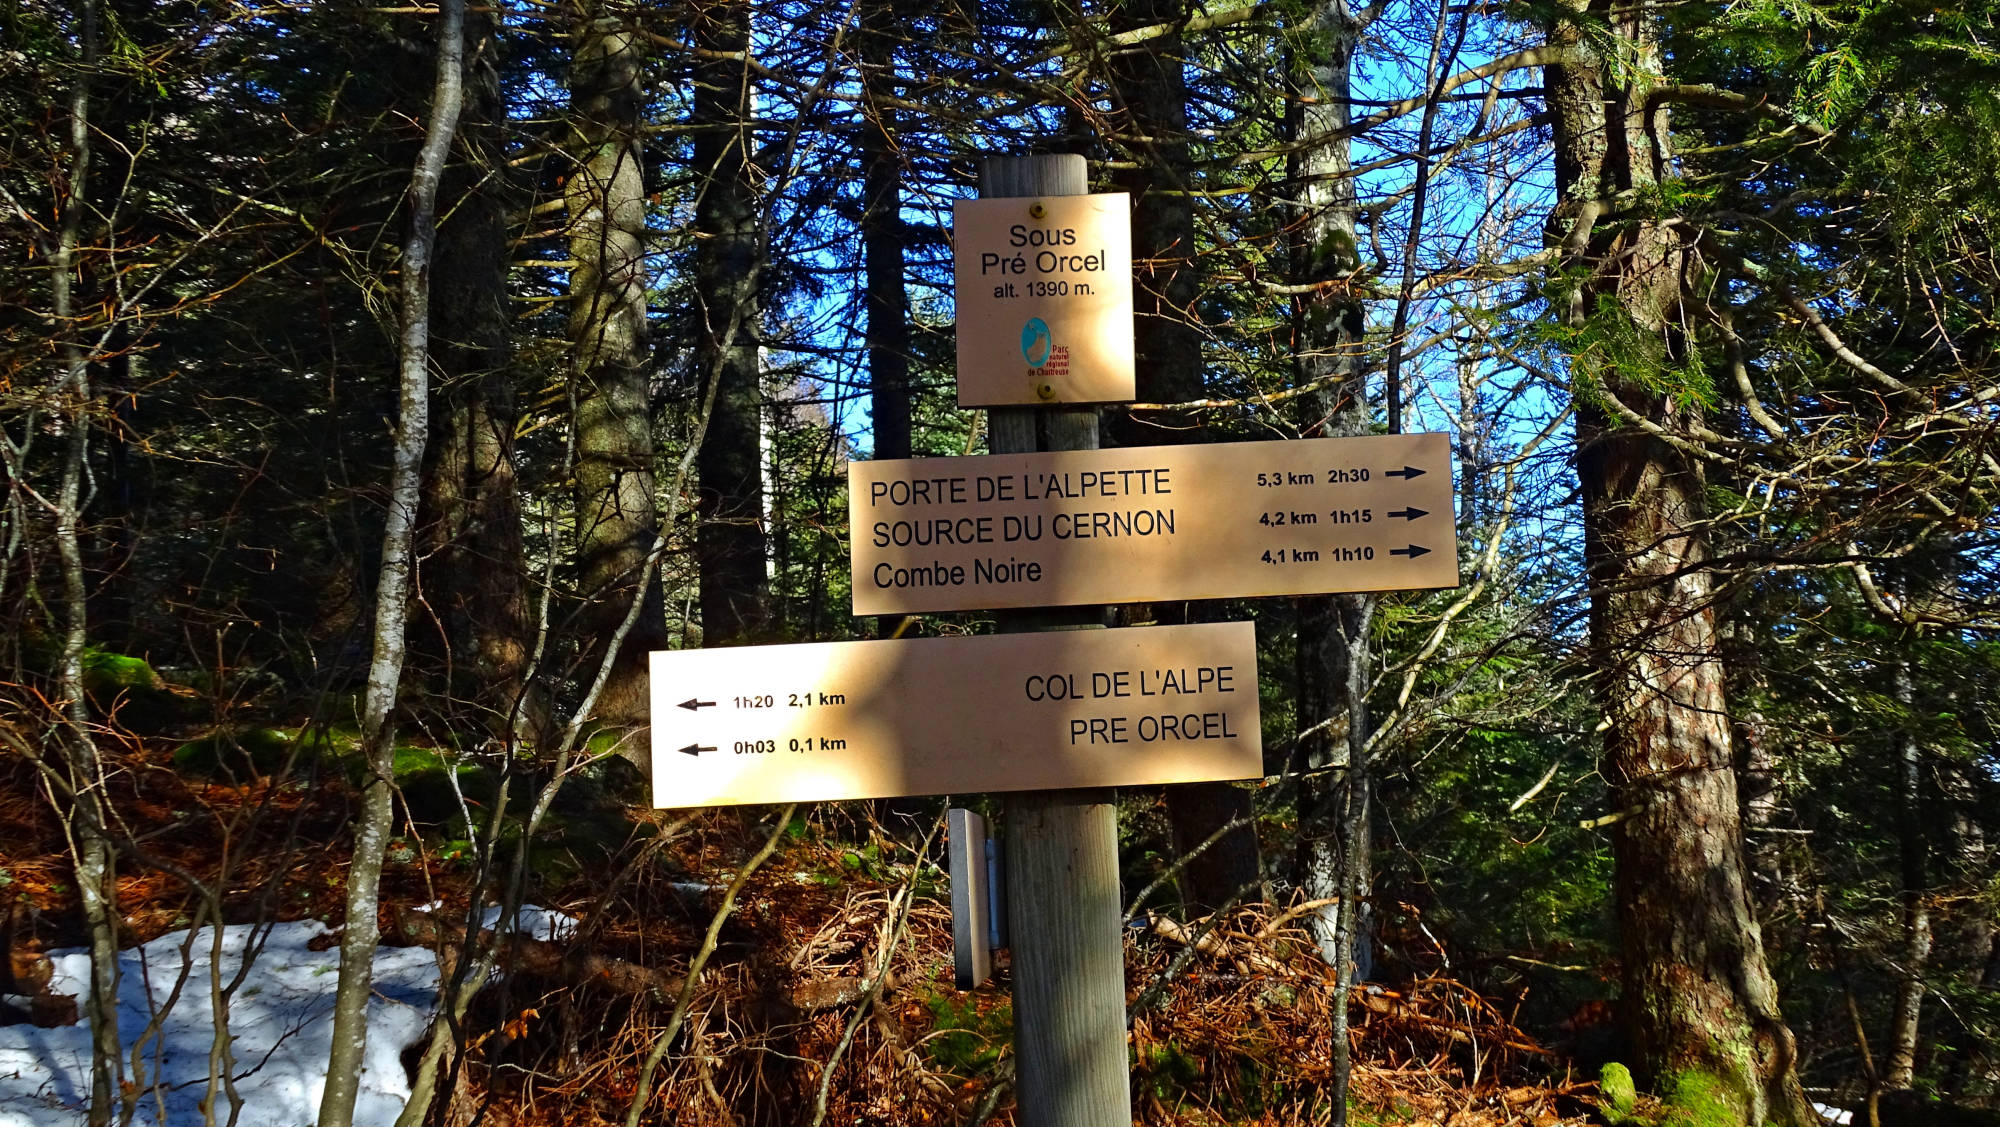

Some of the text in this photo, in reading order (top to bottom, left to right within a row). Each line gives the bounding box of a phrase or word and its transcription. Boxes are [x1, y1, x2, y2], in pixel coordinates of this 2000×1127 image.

[1009, 224, 1077, 247] Sous
[981, 249, 1105, 276] Pré Orcel
[993, 280, 1096, 299] alt. 1390 m.
[871, 468, 1172, 507] PORTE DE L'ALPETTE
[1257, 468, 1371, 487] 5,3 km 2h30
[872, 508, 1176, 548] SOURCE DU CERNON
[1259, 508, 1373, 527] 4,2 km 1h15
[1260, 546, 1375, 566] 4,1 km 1h10
[873, 556, 1042, 589] Combe Noire
[1024, 666, 1235, 702] COL DE L'ALPE
[733, 691, 846, 709] 1h20 2,1 km
[1070, 713, 1238, 746] PRE ORCEL
[733, 736, 847, 755] 0h03 0,1 km
